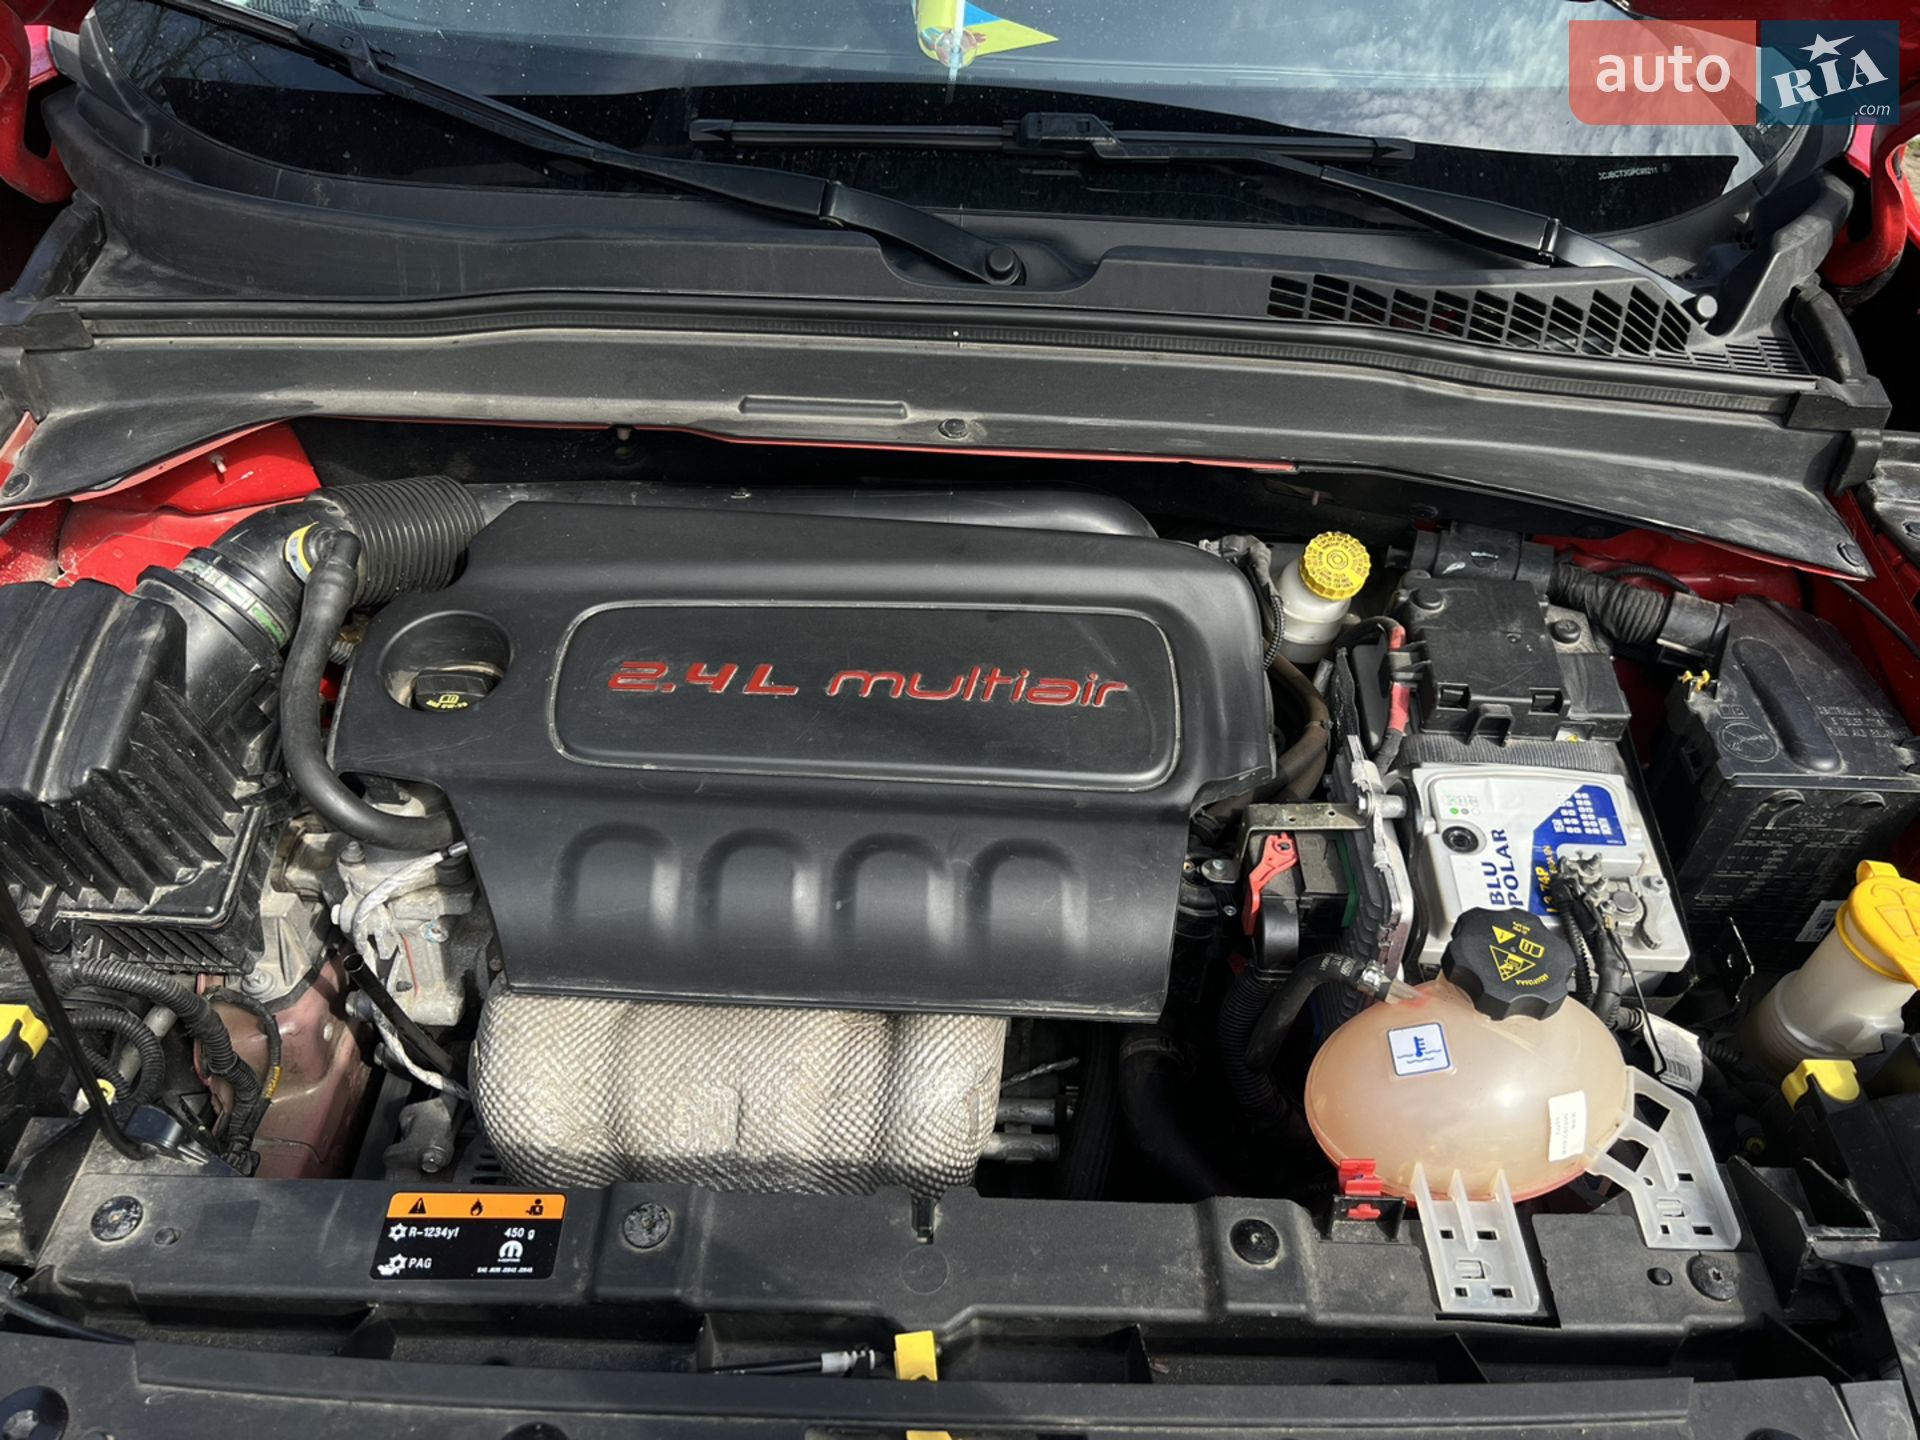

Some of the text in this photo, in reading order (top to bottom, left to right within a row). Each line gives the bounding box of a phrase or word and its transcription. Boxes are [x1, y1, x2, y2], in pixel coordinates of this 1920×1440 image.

[826, 666, 1128, 707] multiair
[1481, 861, 1506, 906] BLU
[1490, 828, 1524, 906] POLAR
[408, 1226, 535, 1240] R-1234yf 450 g
[408, 1258, 432, 1268] PAG
